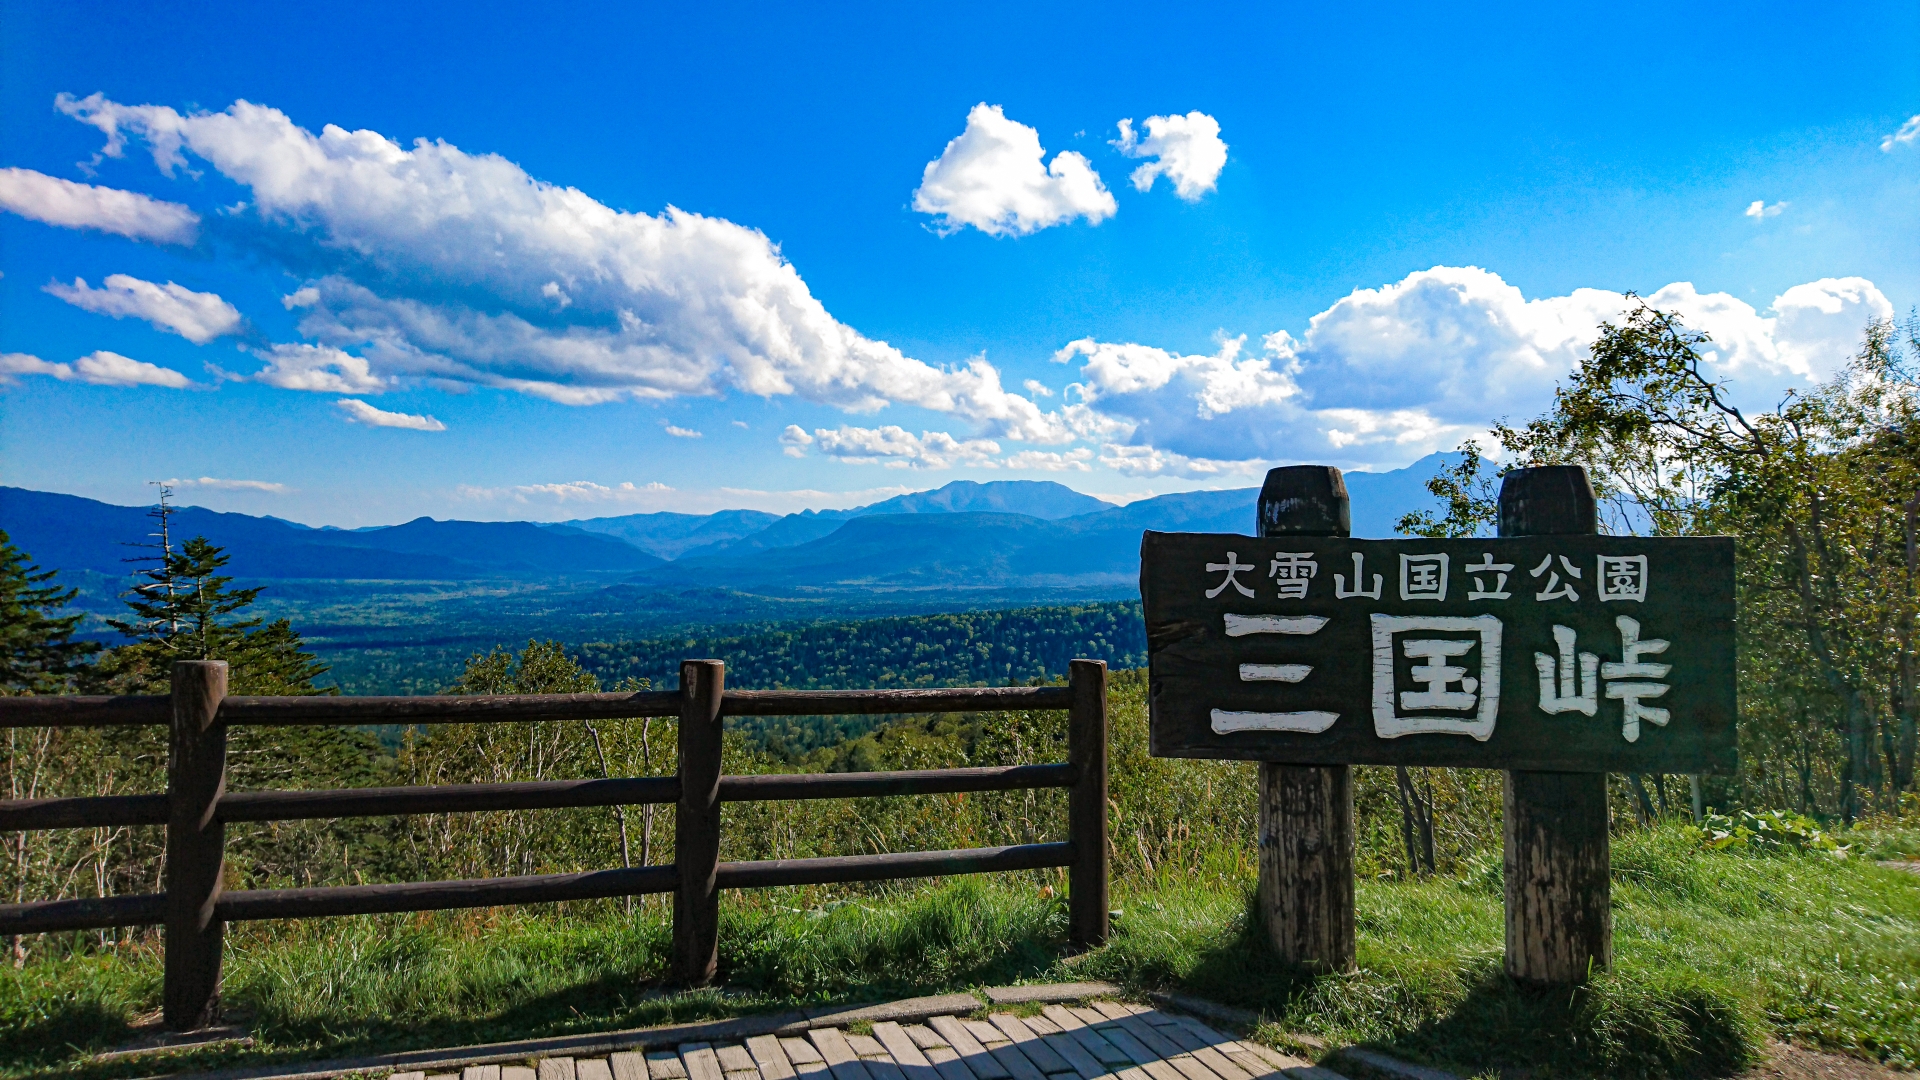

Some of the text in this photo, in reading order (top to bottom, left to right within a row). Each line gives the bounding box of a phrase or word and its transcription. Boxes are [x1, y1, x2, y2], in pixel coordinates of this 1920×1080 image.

[1205, 551, 1649, 603] 大雪山国立公園
[1210, 613, 1673, 743] 三国峠
